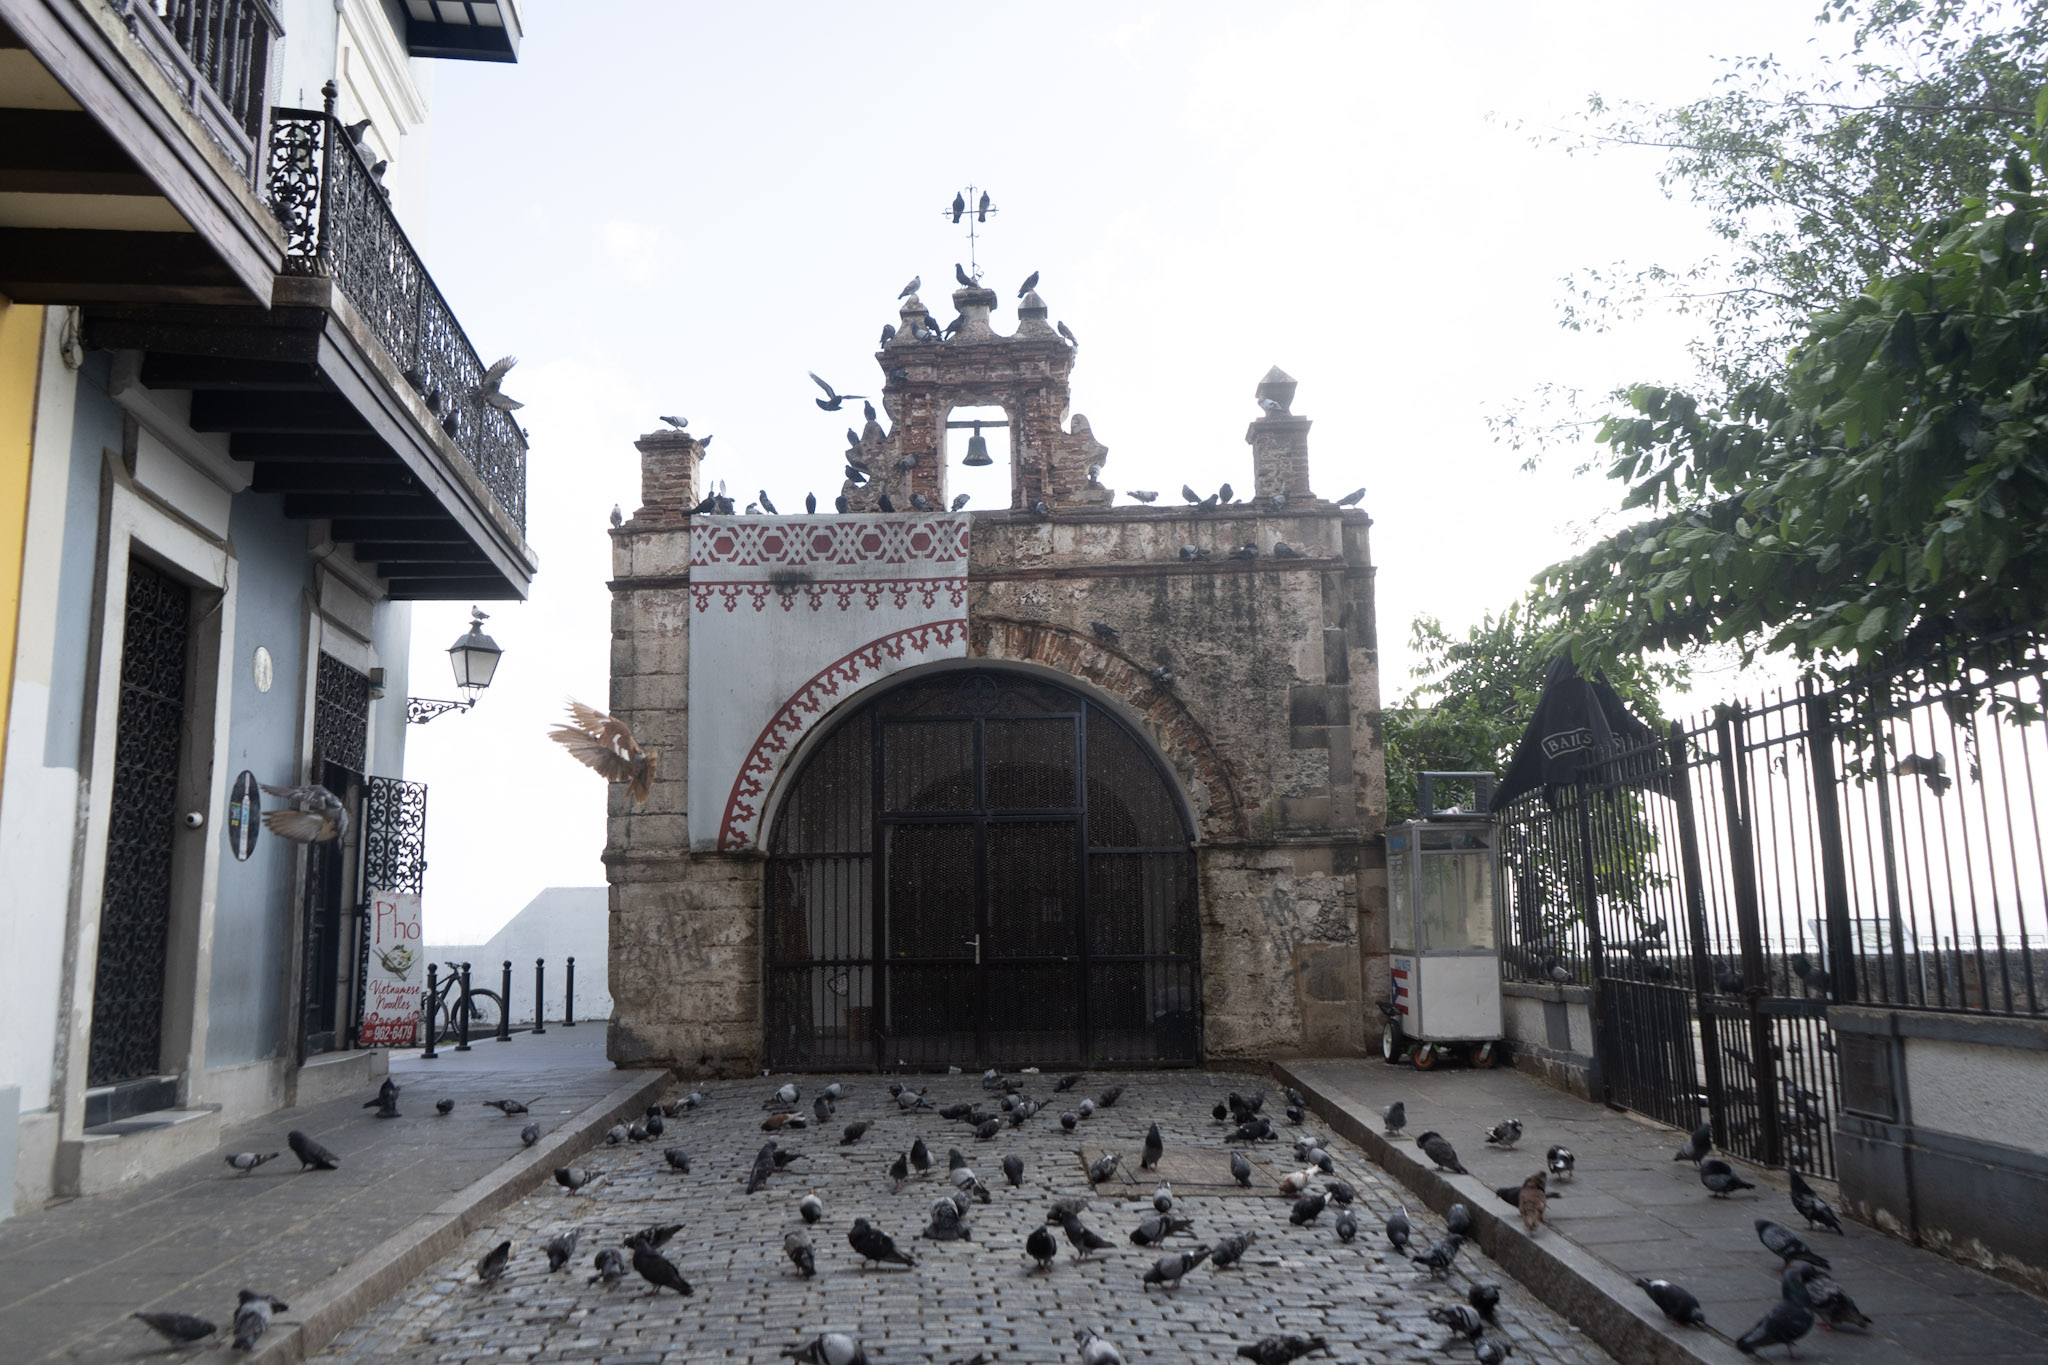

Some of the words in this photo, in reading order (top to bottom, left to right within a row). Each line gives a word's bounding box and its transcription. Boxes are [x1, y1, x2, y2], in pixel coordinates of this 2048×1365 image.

[369, 979, 420, 995] Vietnamese
[376, 995, 411, 1010] Noodles
[374, 1025, 413, 1041] 962-6479
